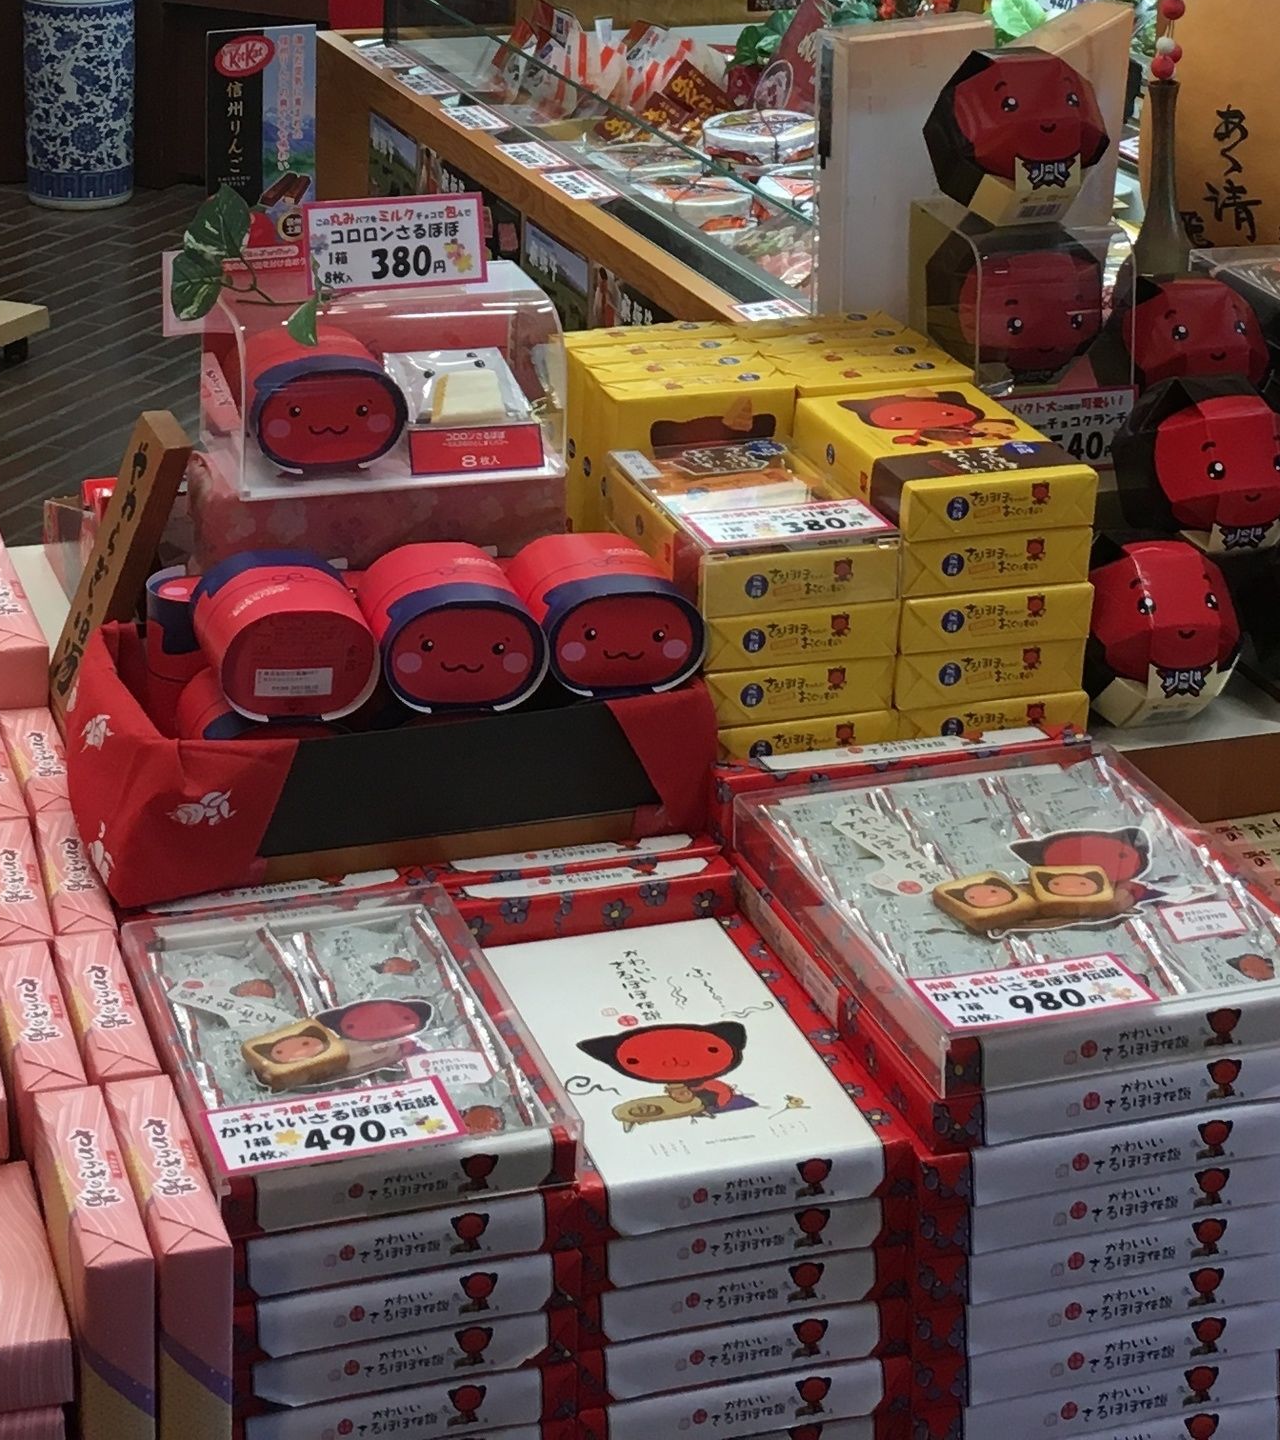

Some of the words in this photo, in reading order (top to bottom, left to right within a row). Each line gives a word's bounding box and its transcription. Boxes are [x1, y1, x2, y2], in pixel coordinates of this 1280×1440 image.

[225, 40, 265, 69] KitKat
[225, 80, 245, 175] 信州りんご
[328, 251, 349, 266] 1箱
[371, 244, 447, 280] 380円
[1047, 412, 1128, 429] チョコクランチ
[461, 454, 501, 468] 8枚入
[782, 517, 865, 535] 380円
[622, 948, 657, 985] かわいい
[931, 967, 1124, 1003] かわいいさるぼぼ伝説
[1008, 987, 1106, 1015] 980円
[219, 1095, 439, 1140] かわいいさるぼぼ伝説
[244, 1136, 272, 1149] 1箱
[304, 1120, 408, 1151] 490円
[384, 1170, 433, 1186] かわいい
[725, 1175, 773, 1191] かわいい
[374, 1231, 424, 1247] かわいい
[724, 1226, 770, 1241] かわいい
[718, 1278, 765, 1294] かわいい
[384, 1292, 433, 1308] かわいい
[722, 1335, 769, 1351] かわいい
[378, 1345, 428, 1361] かわいい
[725, 1394, 772, 1411] かわいい
[372, 1403, 421, 1420] かわいい
